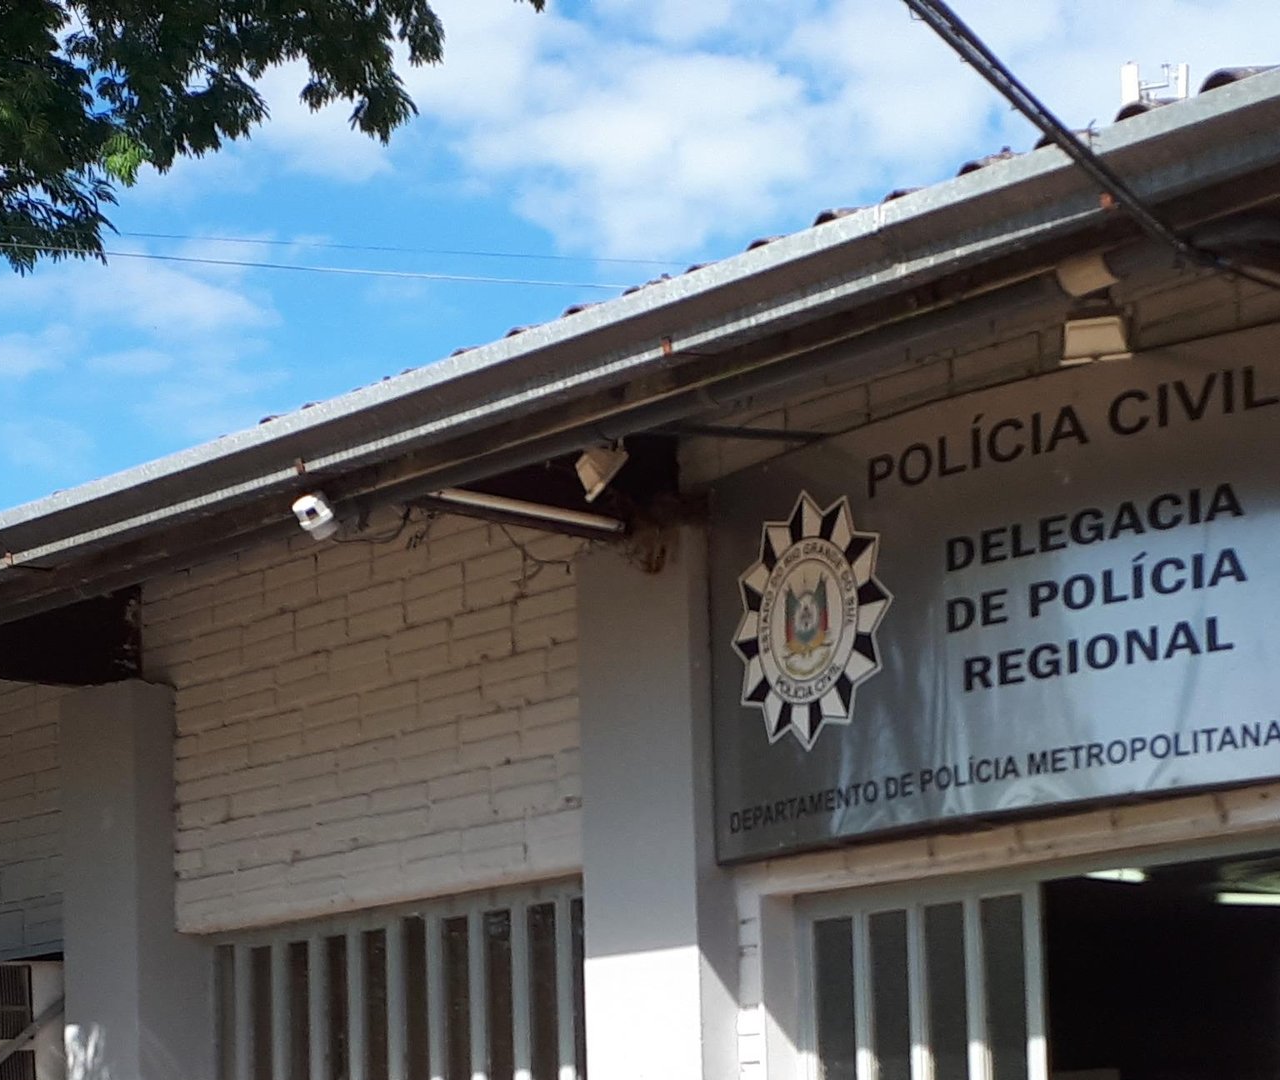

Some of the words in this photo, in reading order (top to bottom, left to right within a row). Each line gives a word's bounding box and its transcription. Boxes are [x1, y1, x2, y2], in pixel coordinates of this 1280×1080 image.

[867, 412, 1089, 498] POLÍCIA
[1107, 365, 1280, 436] CIVIL
[945, 482, 1244, 572] DELEGACIA
[946, 588, 1008, 634] DE
[1028, 547, 1248, 618] POLÍCIA
[963, 616, 1234, 692] REGIONAL
[729, 781, 879, 834] DEPARTAMENTO
[884, 772, 914, 799] DE
[920, 756, 1019, 792] POLÍCIA
